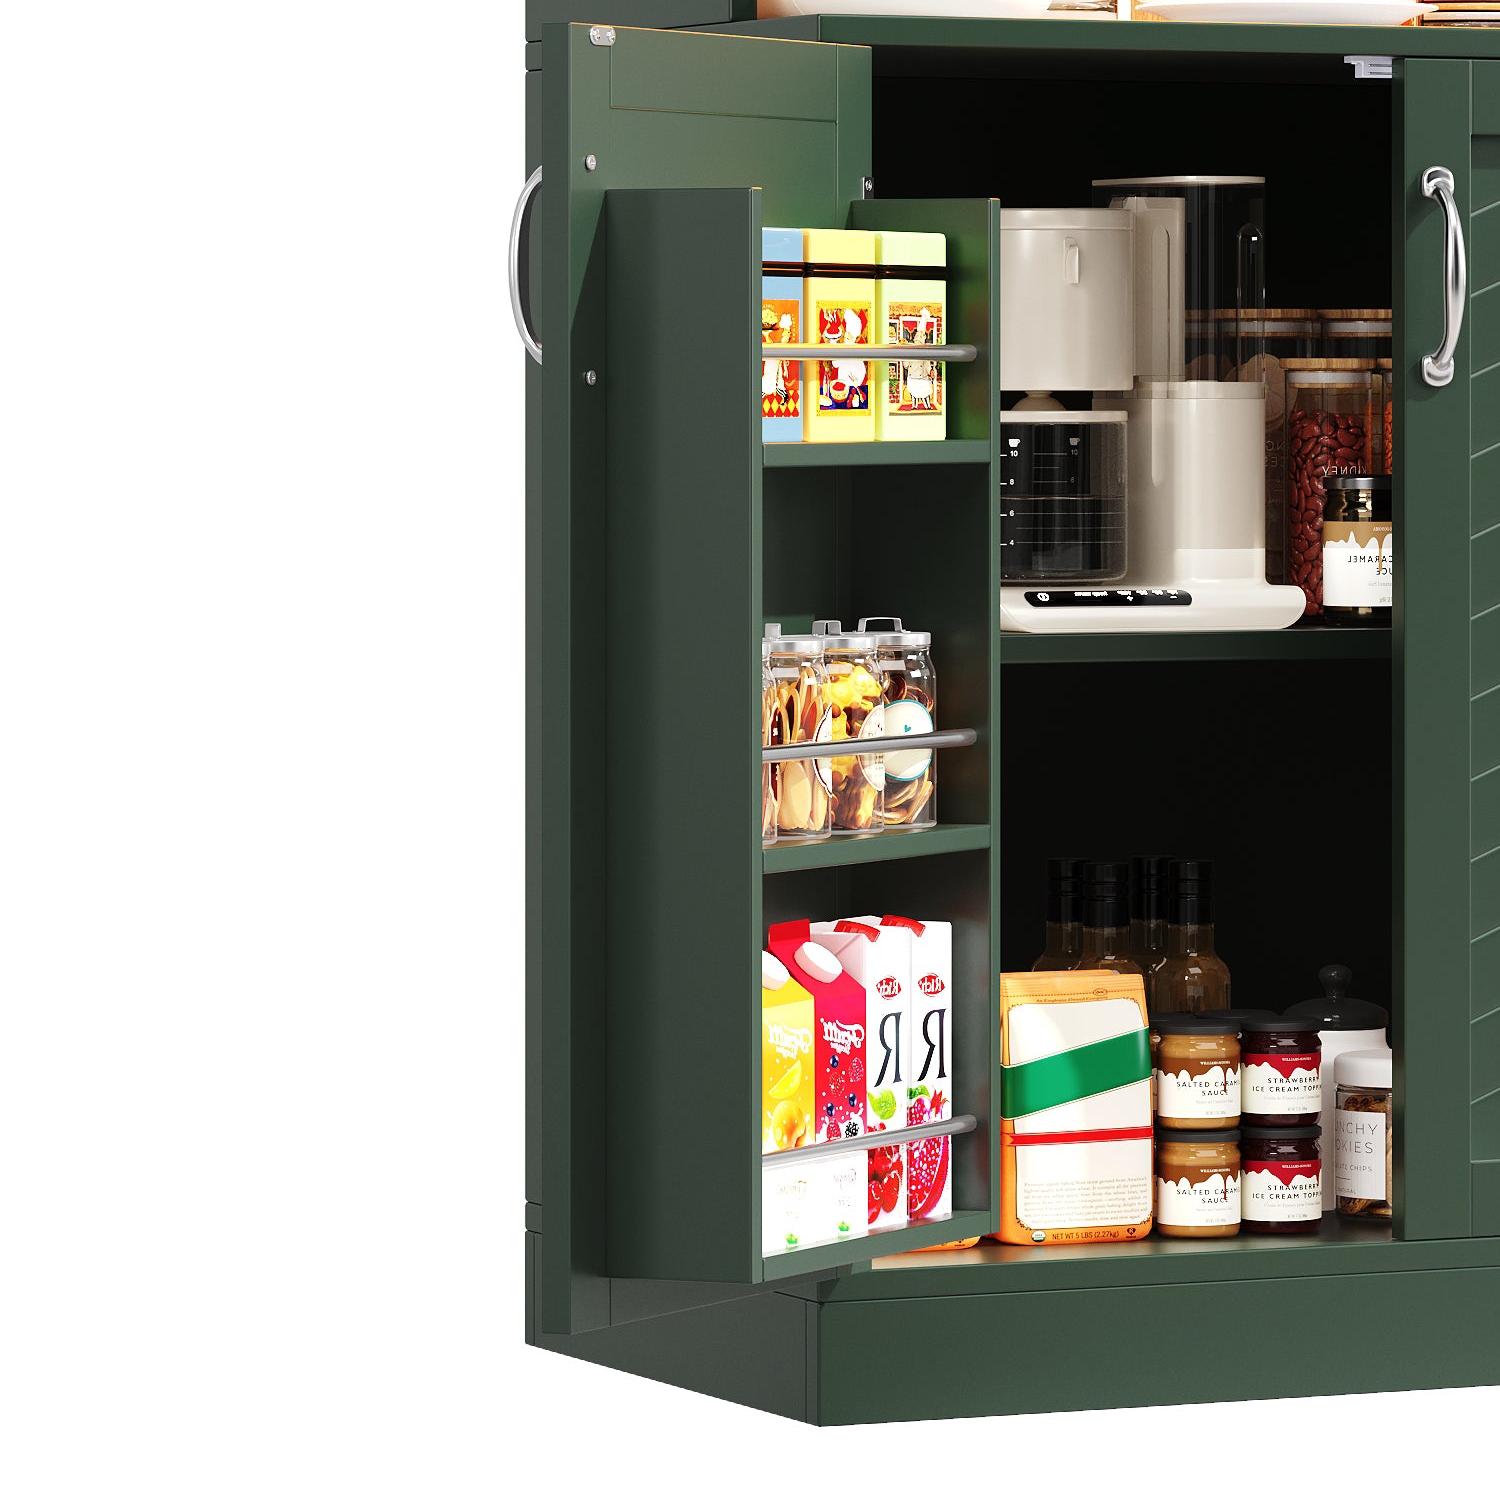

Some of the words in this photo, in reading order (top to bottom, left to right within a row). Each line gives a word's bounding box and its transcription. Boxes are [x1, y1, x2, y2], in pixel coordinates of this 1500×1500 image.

[1009, 478, 1015, 486] 8
[1009, 509, 1015, 517] 6
[1269, 1085, 1300, 1093] CREAM
[1349, 1164, 1373, 1172] CHIPS
[1176, 1188, 1211, 1196] SALTED
[1081, 1231, 1093, 1239] LBS
